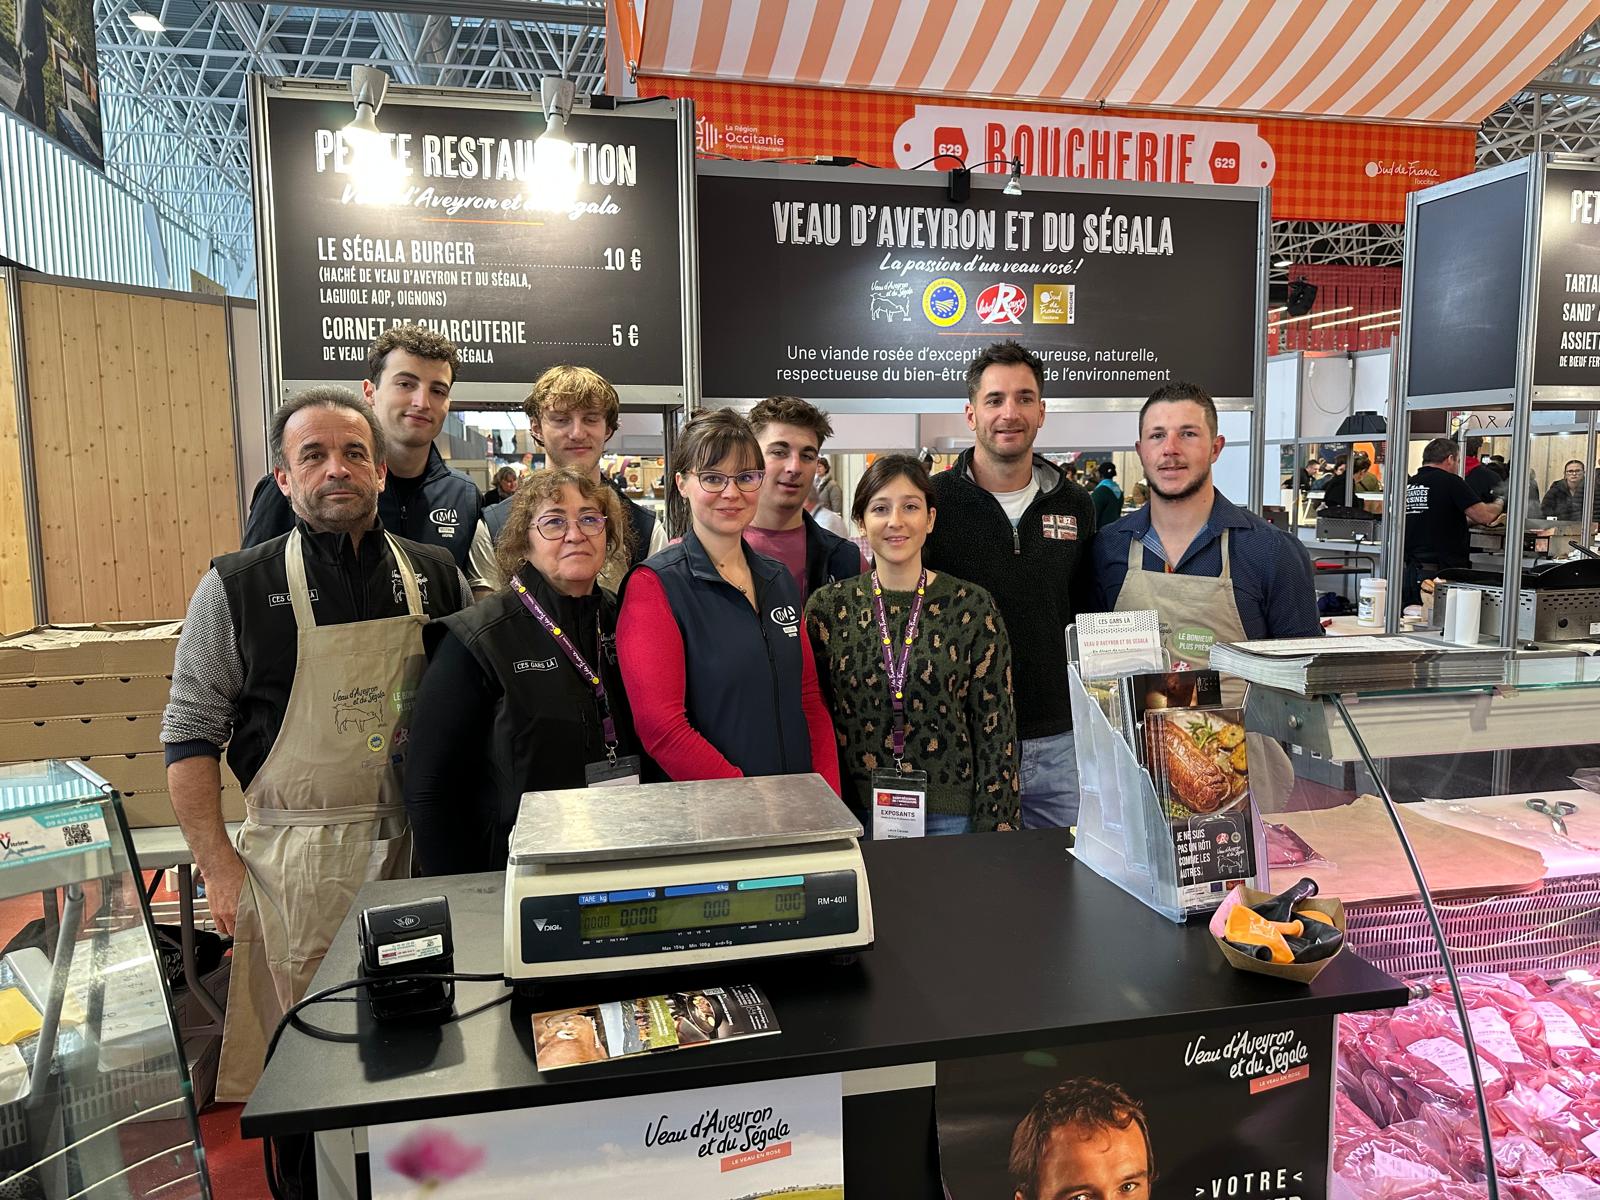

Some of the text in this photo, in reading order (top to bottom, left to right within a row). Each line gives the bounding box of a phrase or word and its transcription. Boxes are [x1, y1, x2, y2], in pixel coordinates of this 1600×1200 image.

[725, 132, 784, 146] Occitanie
[315, 129, 637, 187] PETE RESTAUTION
[938, 143, 962, 156] 629
[984, 122, 1195, 185] BOUCHERIE
[1214, 157, 1236, 169] 629
[1377, 160, 1440, 177] Sud de France
[500, 192, 522, 210] et
[772, 200, 1175, 256] VEAU D'AVEYRON ET DU SÉGALA
[317, 233, 642, 272] LE SÉGALA BURGER 10 €
[879, 251, 904, 271] La
[900, 256, 963, 277] passion
[963, 254, 1002, 273] d'un
[1002, 260, 1042, 275] veau
[318, 265, 532, 290] (HACHÉ DE VEAU D'AVEYRON ET DU SÉGALA,
[1565, 273, 1600, 293] TARTA
[319, 288, 447, 307] LAGUIOLE AOP, OIGNONS)
[1040, 302, 1064, 315] France
[1562, 302, 1595, 322] SAND'
[322, 316, 387, 341] CORNET
[612, 324, 623, 347] 5
[628, 324, 639, 347] €
[1560, 331, 1600, 351] ASSIET
[323, 346, 365, 362] DE VEAU
[456, 346, 494, 364] SÉGALA
[787, 345, 982, 365] Une viande rosée d'excepti
[1030, 348, 1158, 363] oureuse, naturelle,
[1559, 355, 1600, 368] DE BŒUF FER
[776, 366, 968, 384] respectueuse du bien-être
[1043, 367, 1171, 382] de l'environnement
[271, 595, 285, 603] CES
[1178, 632, 1213, 643] LE BONHEUR
[1179, 641, 1194, 650] PLUS
[333, 689, 348, 702] Veau
[881, 809, 915, 818] EXPOSANTS
[1176, 828, 1206, 842] JE NE SUIS
[1177, 843, 1189, 854] PAS
[1200, 852, 1211, 863] LES
[582, 894, 608, 903] TARE kg
[647, 890, 656, 898] kg
[1184, 1029, 1294, 1067] Veau d'Aveyron
[1229, 1040, 1309, 1079] et du Ségala
[645, 1106, 773, 1147] Veau d'Aveyron
[698, 1118, 791, 1158] et du Ségala
[739, 1154, 755, 1163] VEAU
[756, 1152, 765, 1160] EN
